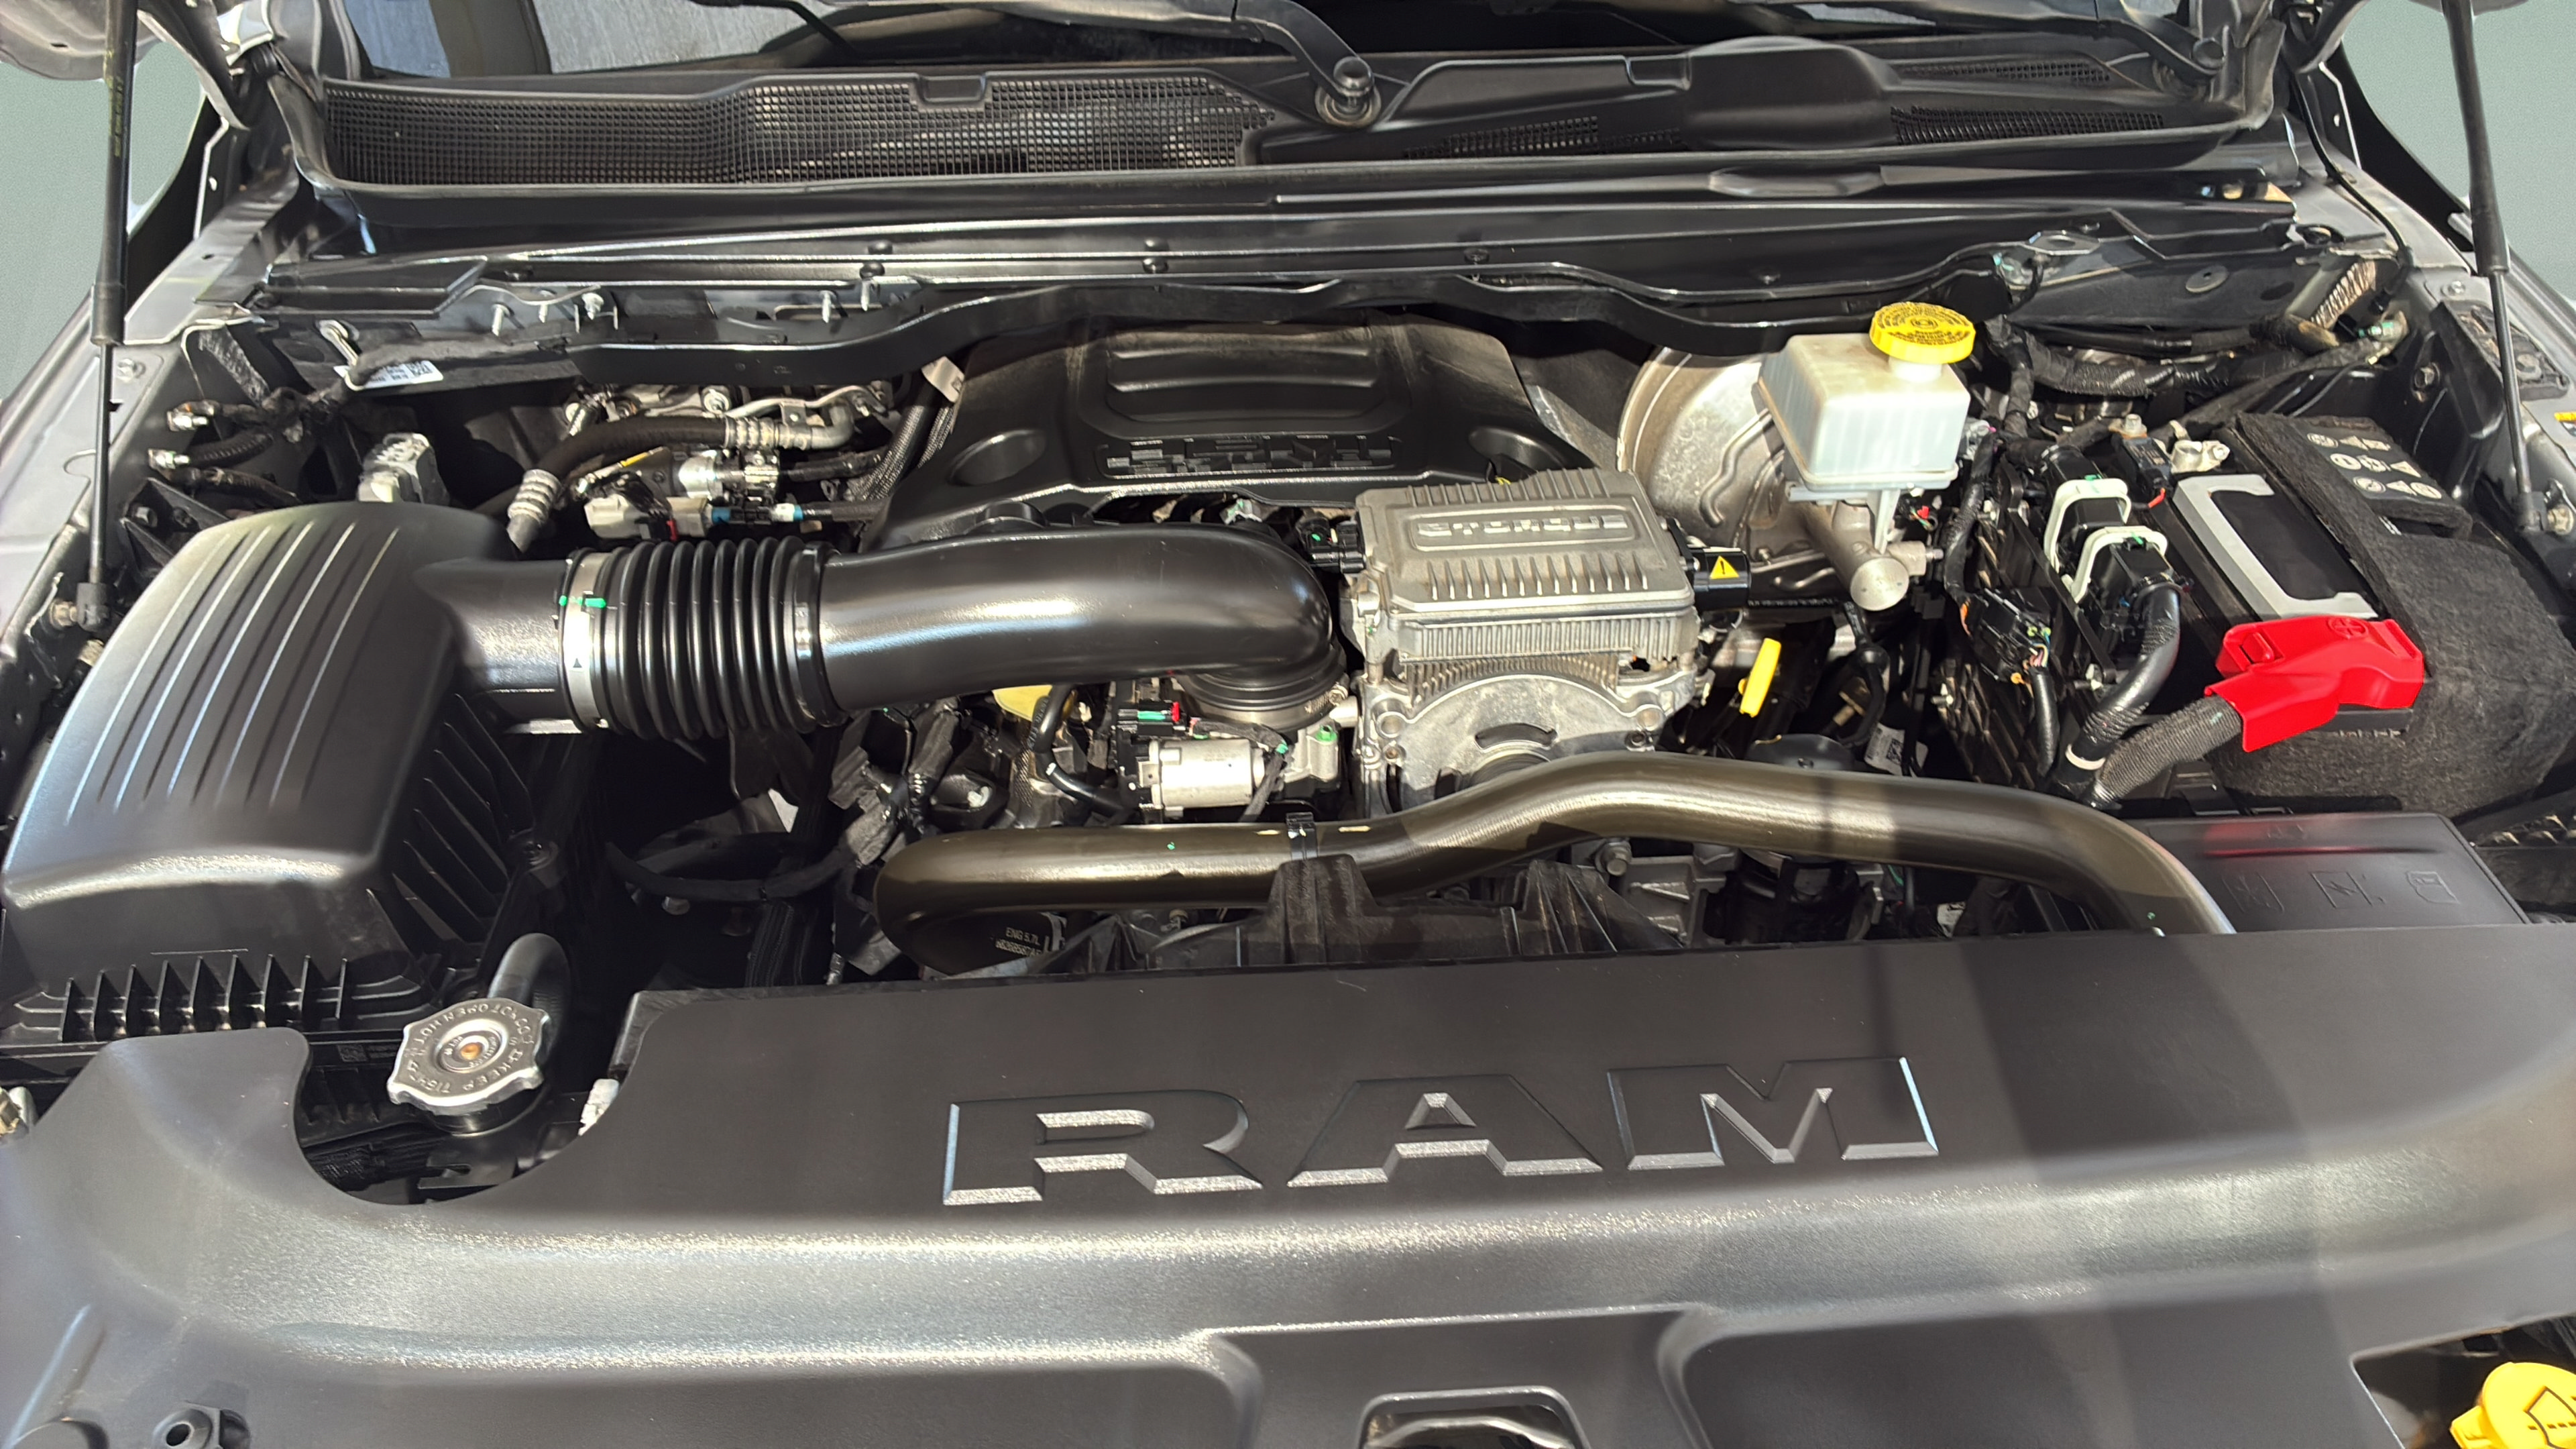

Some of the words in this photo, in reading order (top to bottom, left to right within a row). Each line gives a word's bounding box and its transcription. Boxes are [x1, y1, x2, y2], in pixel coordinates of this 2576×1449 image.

[443, 1003, 490, 1022] OPEN
[414, 1020, 443, 1045] HOT
[944, 1056, 1939, 1205] RAM
